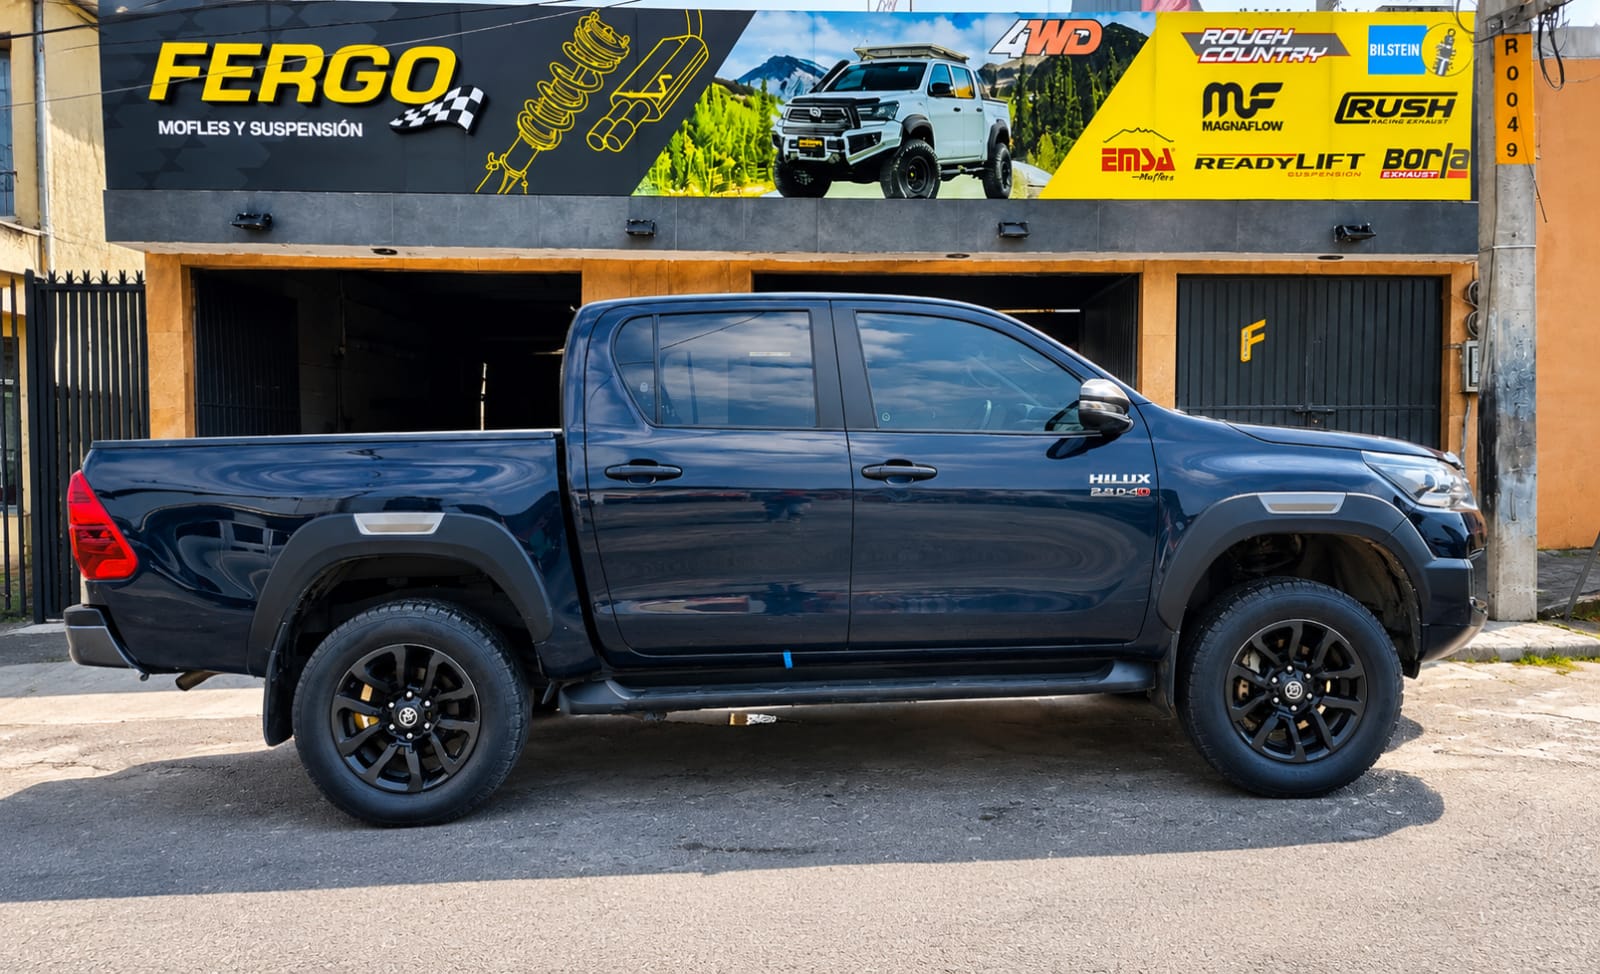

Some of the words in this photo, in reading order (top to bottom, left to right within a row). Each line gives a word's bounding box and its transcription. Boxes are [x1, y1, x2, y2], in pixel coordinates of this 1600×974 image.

[989, 18, 1103, 58] 4WD
[1199, 28, 1296, 45] ROUGH
[1198, 47, 1329, 63] COUNTRY
[1369, 44, 1420, 57] BILSTEIN
[149, 42, 457, 104] FERGO
[1346, 98, 1457, 118] RUSH
[158, 120, 229, 136] MOFLES
[233, 121, 246, 136] Y
[250, 119, 363, 137] SUSPENSIÓN
[1202, 121, 1284, 132] MAGNAFLOW
[1101, 148, 1176, 172] EMSA
[1194, 153, 1366, 170] READYLIFT
[1382, 171, 1438, 179] EXHAUST
[1241, 319, 1267, 363] F
[1089, 473, 1151, 485] HILUX
